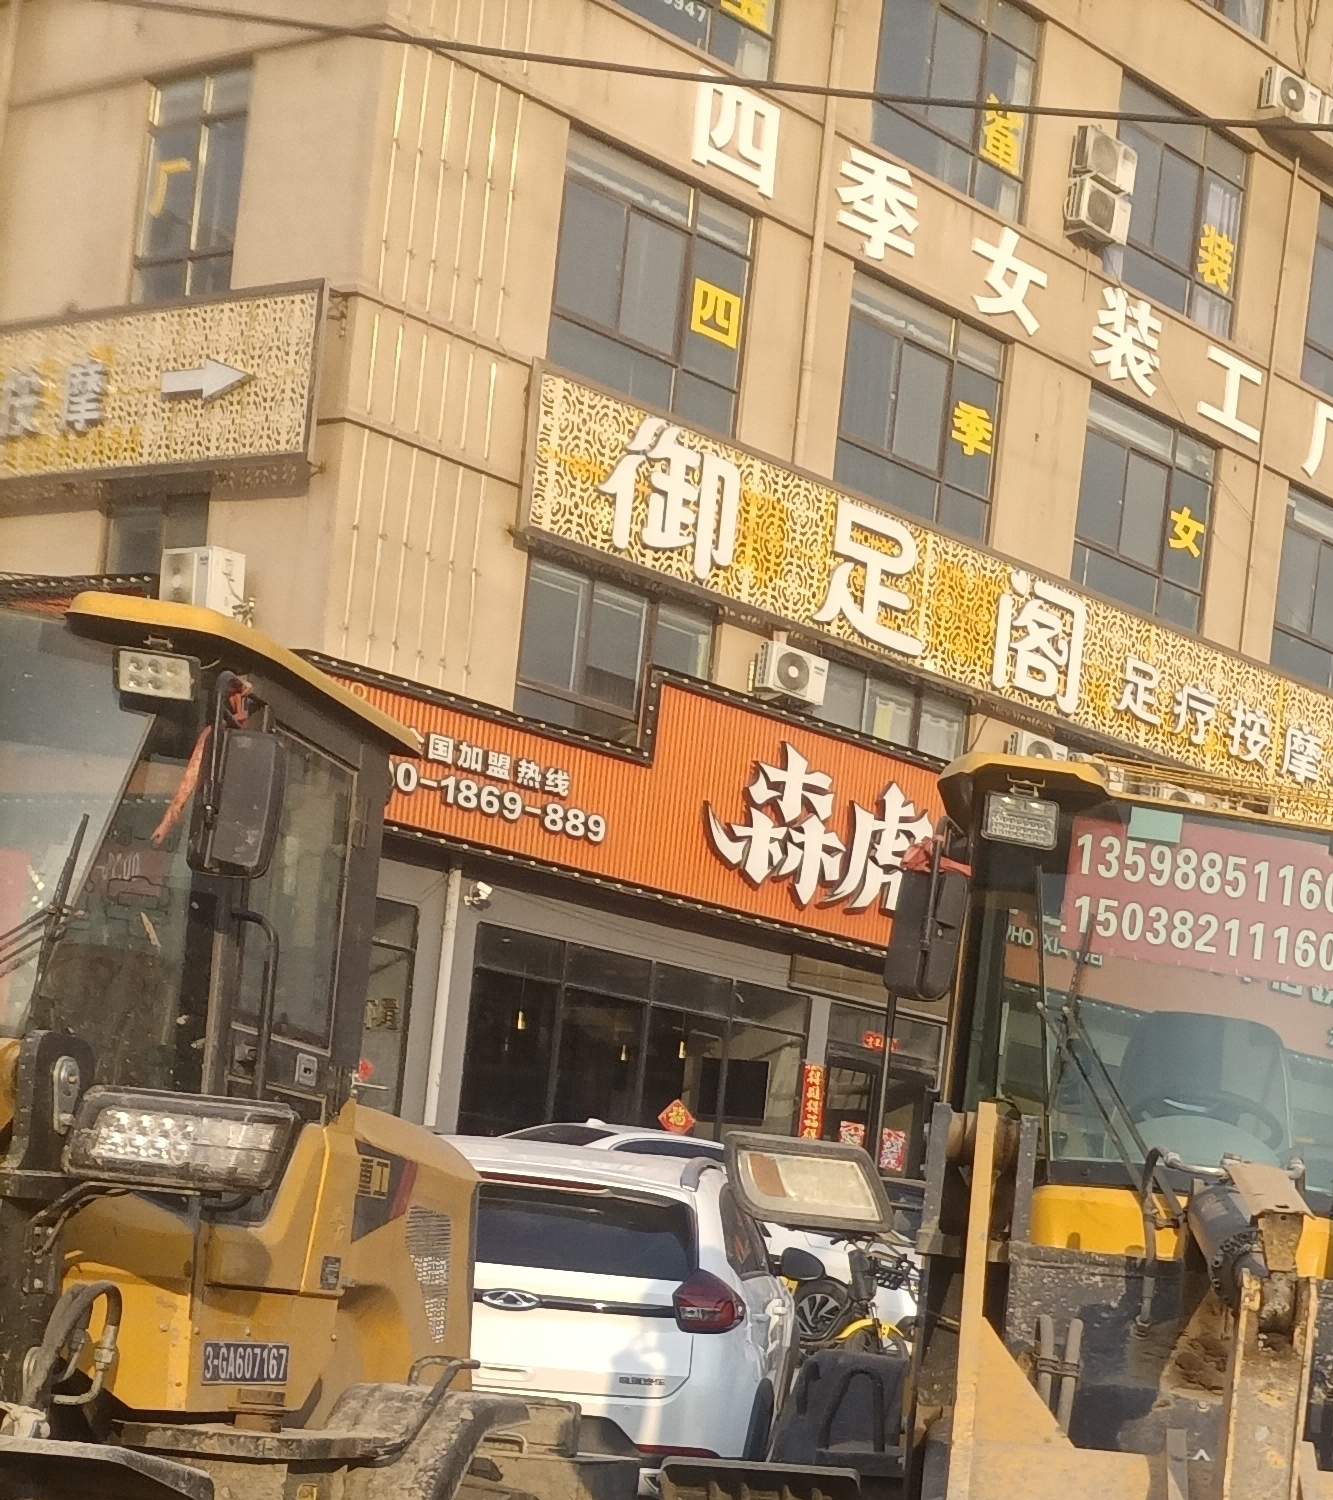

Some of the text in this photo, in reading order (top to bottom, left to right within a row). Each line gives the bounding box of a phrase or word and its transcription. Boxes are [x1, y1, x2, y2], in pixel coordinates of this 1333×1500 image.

[1197, 224, 1233, 293] 装
[600, 417, 1084, 715] 御足阁
[388, 761, 607, 844] 0-1869-889
[204, 1345, 289, 1381] 3-GA607167
